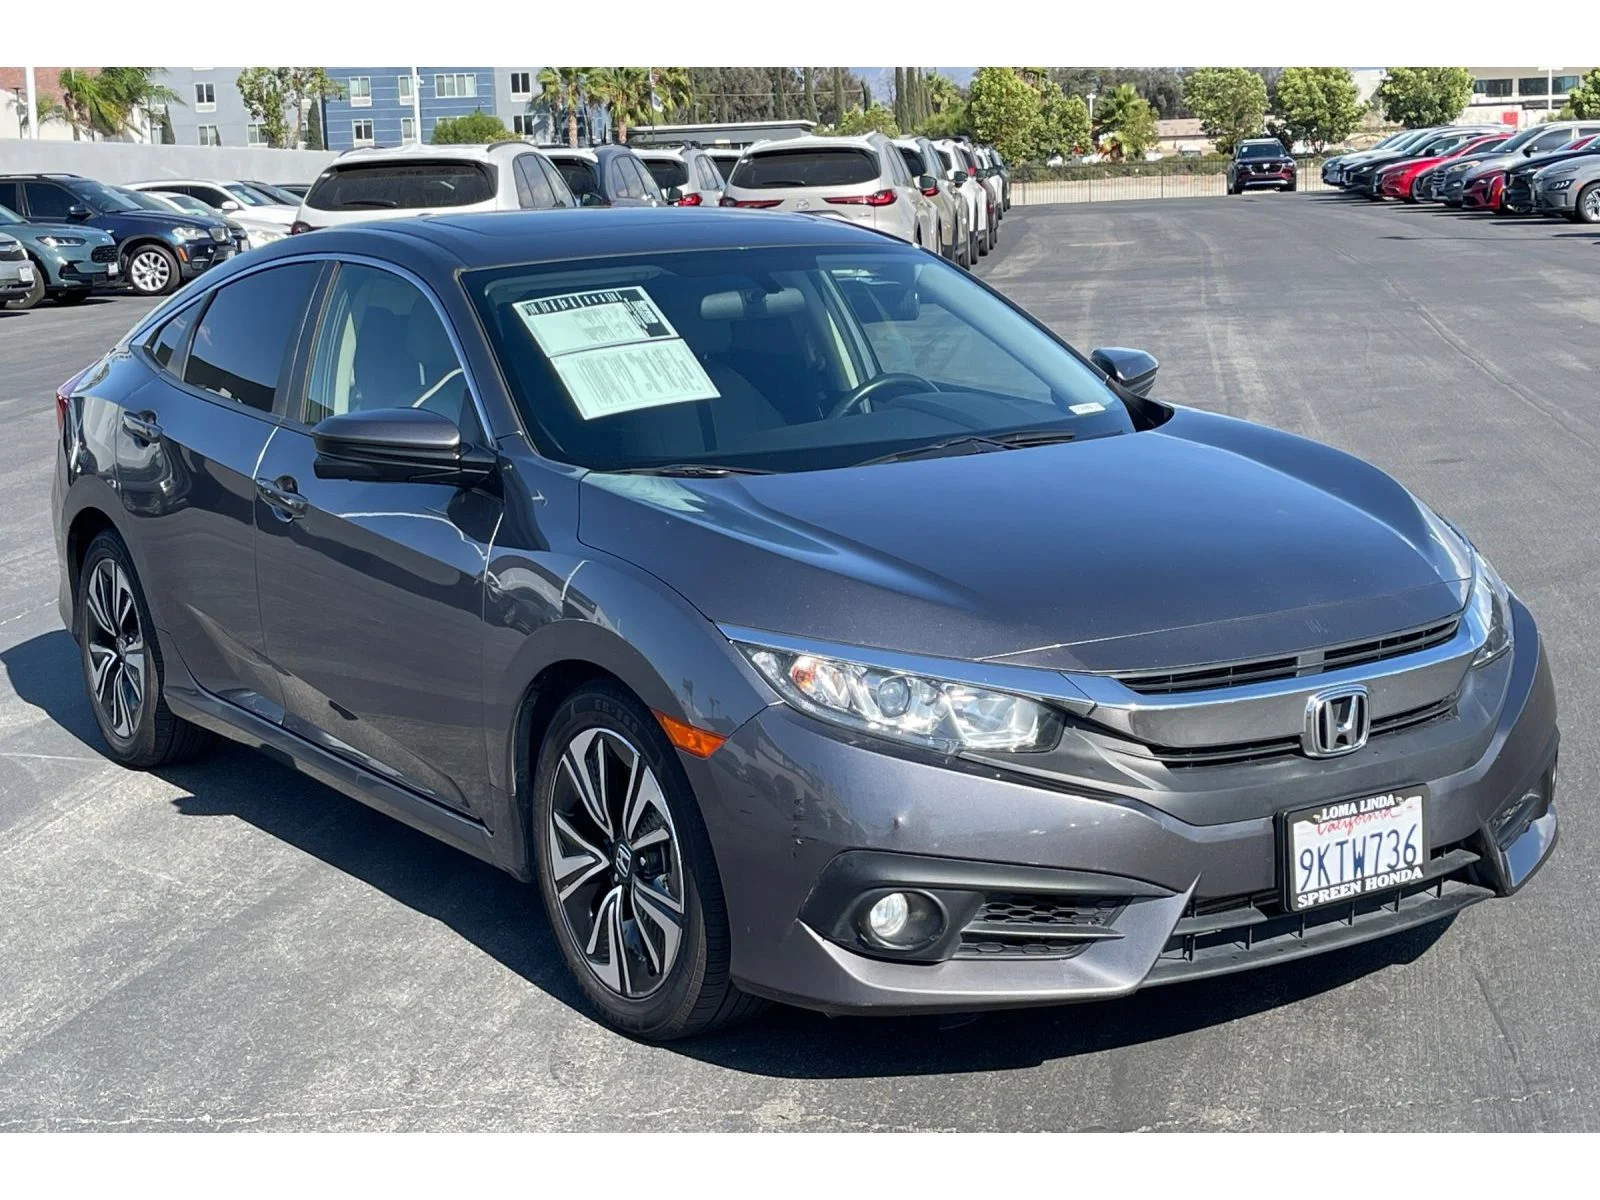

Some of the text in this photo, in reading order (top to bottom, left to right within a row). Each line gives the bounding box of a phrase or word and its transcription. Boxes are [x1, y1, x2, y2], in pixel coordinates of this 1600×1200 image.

[1322, 794, 1395, 820] LOMA LINDA
[1300, 824, 1417, 892] 9KTW736
[1298, 867, 1424, 908] SPREEN HONDA
